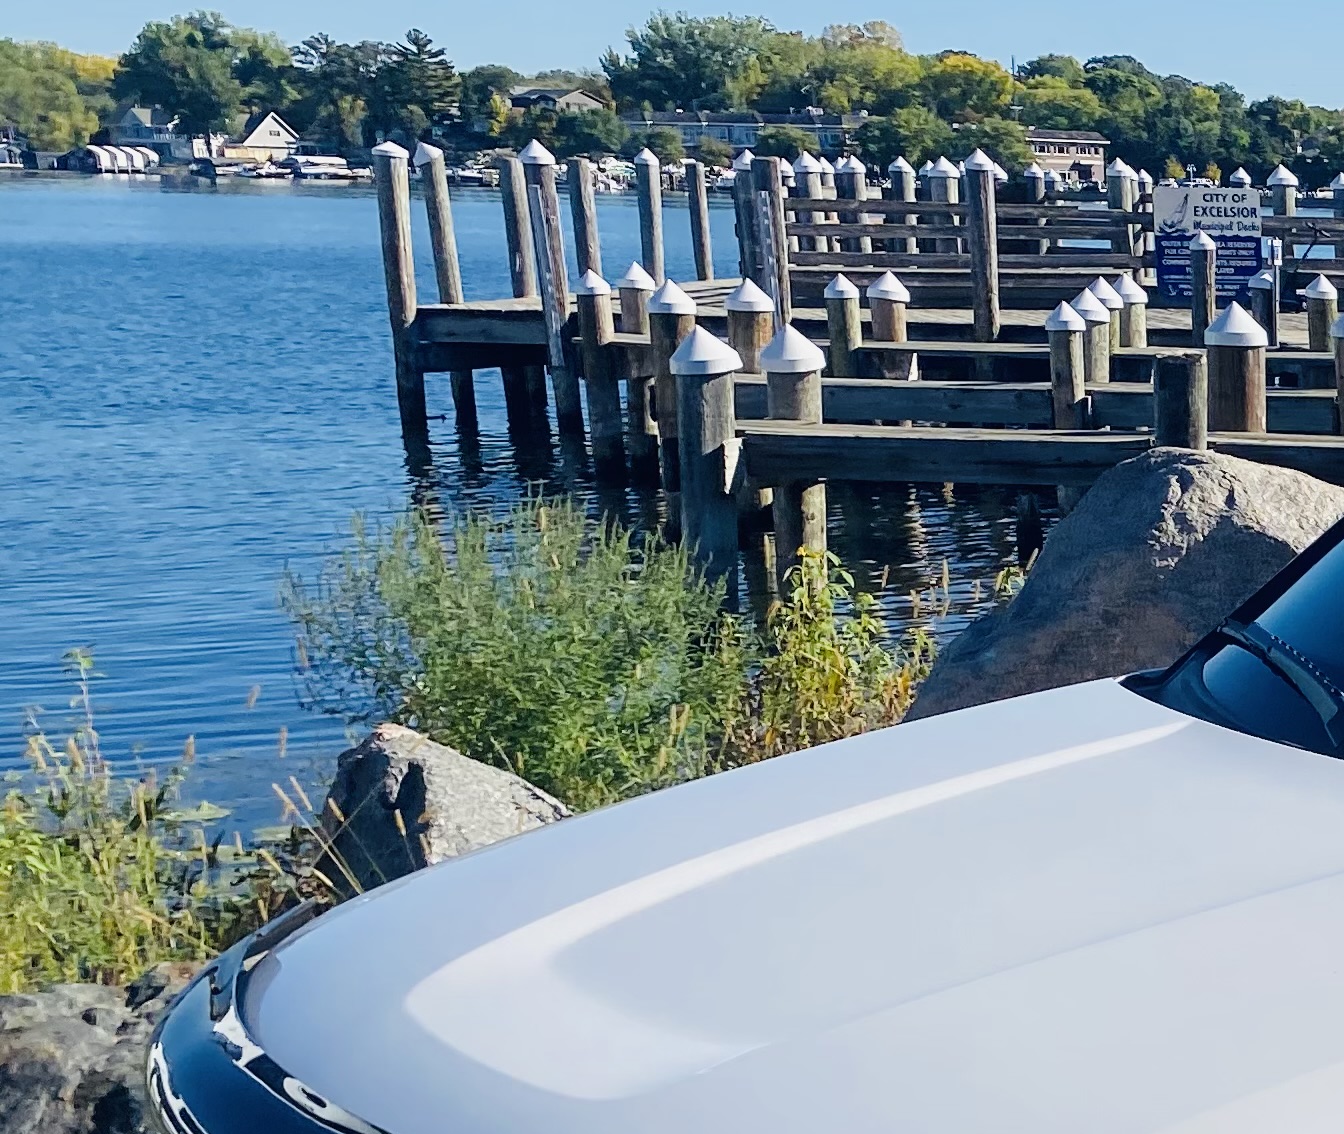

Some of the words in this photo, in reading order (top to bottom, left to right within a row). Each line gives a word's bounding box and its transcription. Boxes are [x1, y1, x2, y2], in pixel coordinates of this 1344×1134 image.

[1202, 193, 1227, 202] CITY
[1232, 193, 1247, 203] OF
[1193, 206, 1257, 218] EXCELSIOR
[1237, 221, 1260, 231] Docks
